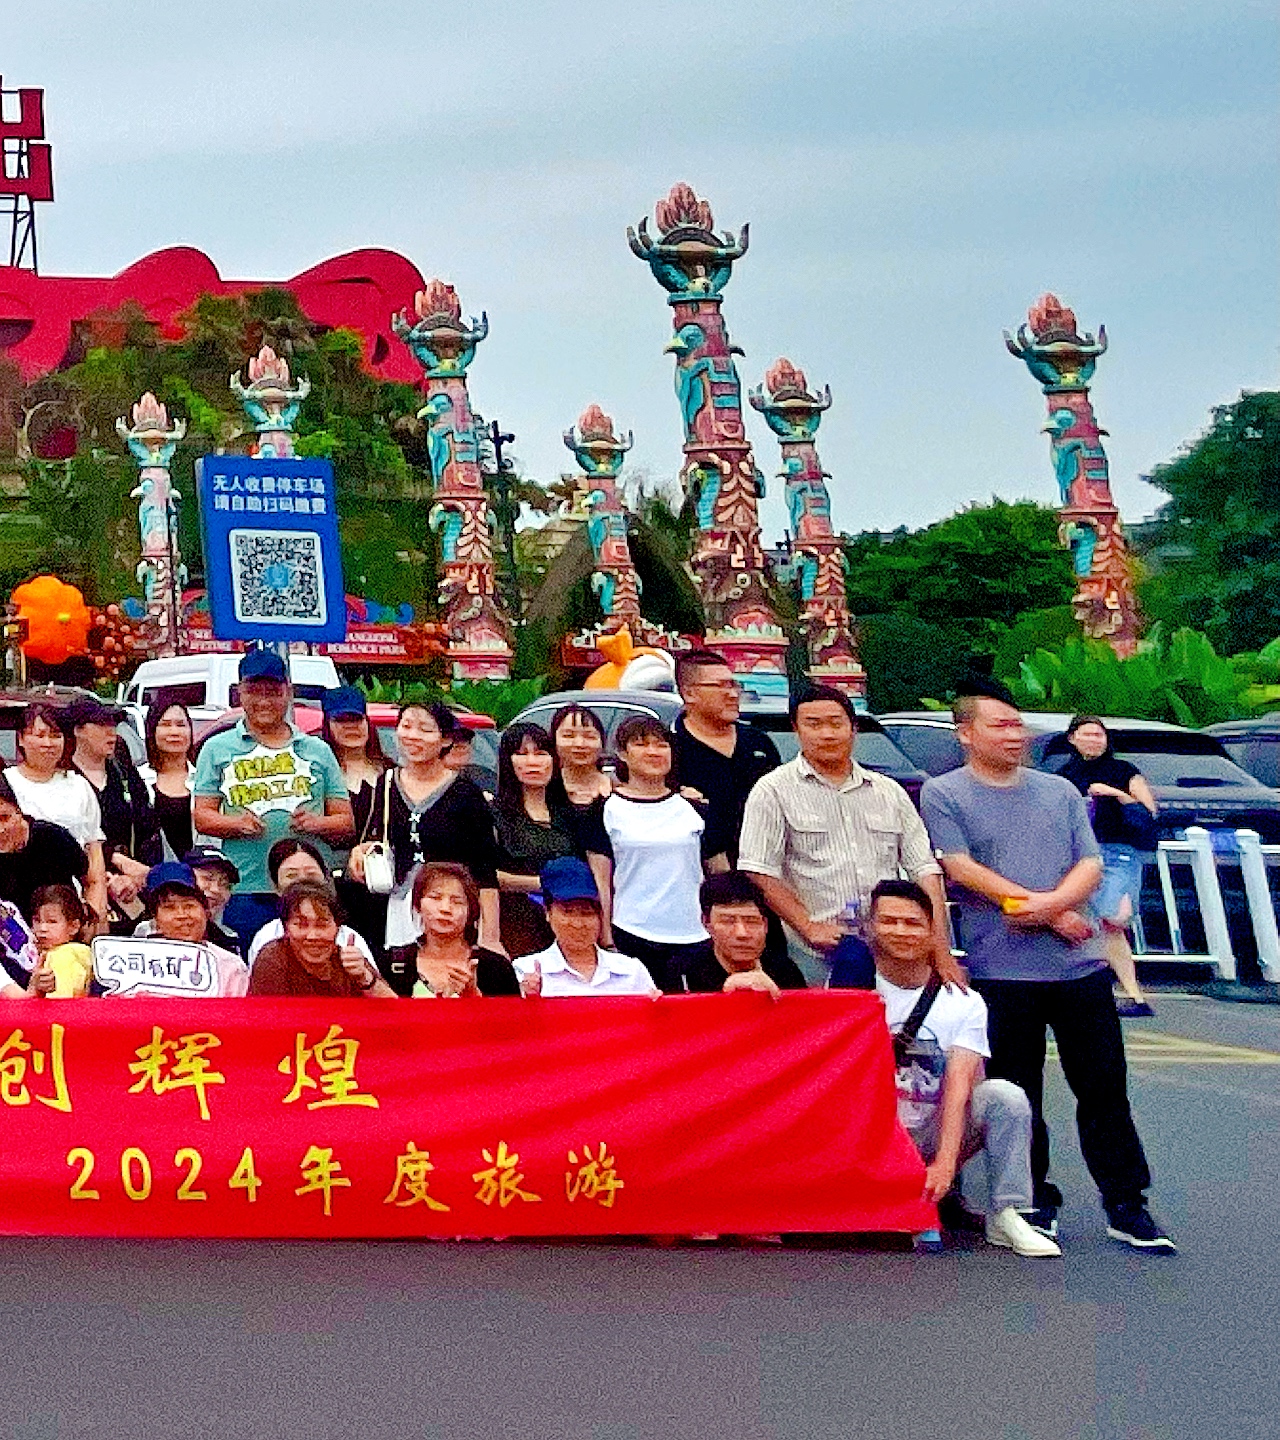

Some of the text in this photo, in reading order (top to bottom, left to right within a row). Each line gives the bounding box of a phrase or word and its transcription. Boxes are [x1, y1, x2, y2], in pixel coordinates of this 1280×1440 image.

[213, 474, 325, 494] 无人收费停车场
[108, 952, 193, 979] 公司有矿
